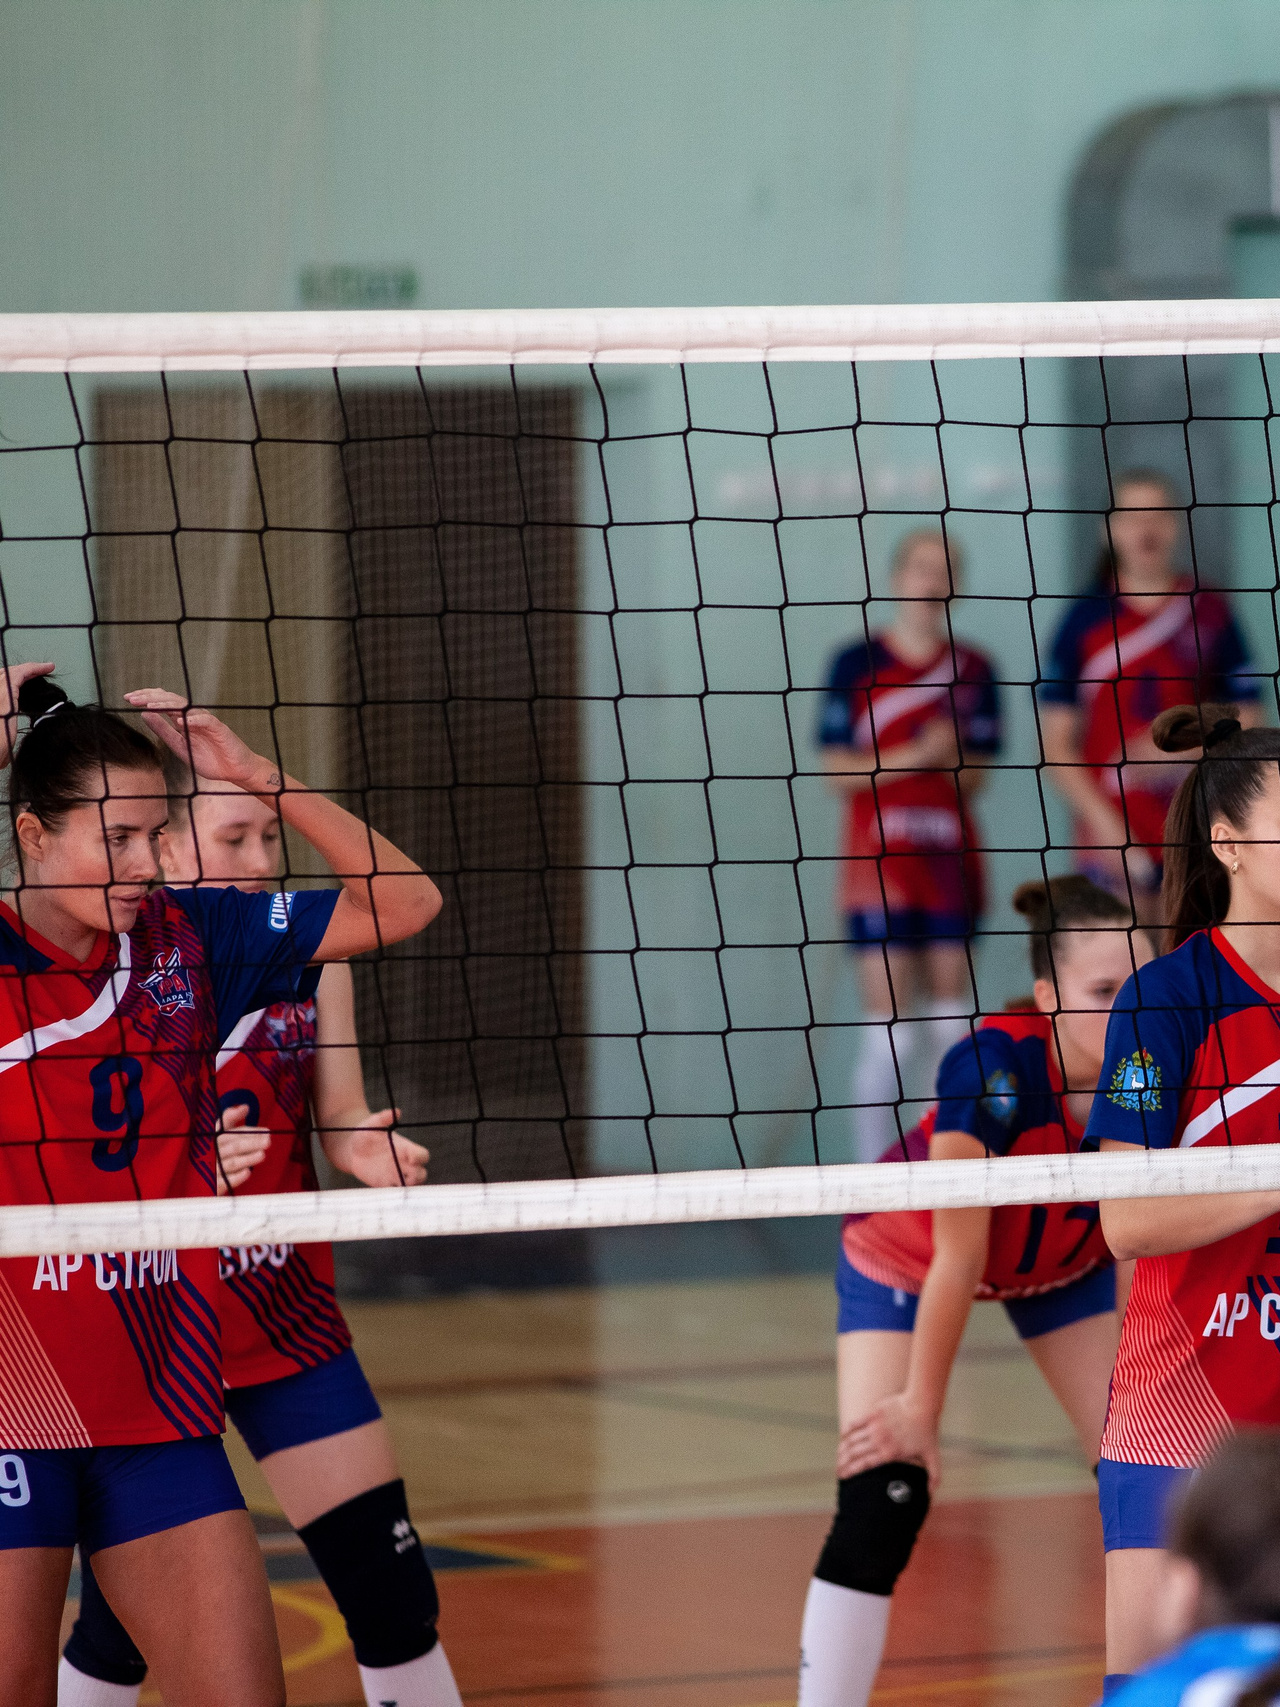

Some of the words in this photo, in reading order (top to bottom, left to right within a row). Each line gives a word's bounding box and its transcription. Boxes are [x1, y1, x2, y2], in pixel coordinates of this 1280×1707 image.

[89, 1056, 144, 1172] 9
[32, 1253, 83, 1291] АР
[1202, 1292, 1249, 1338] АР
[0, 1453, 31, 1508] 9
